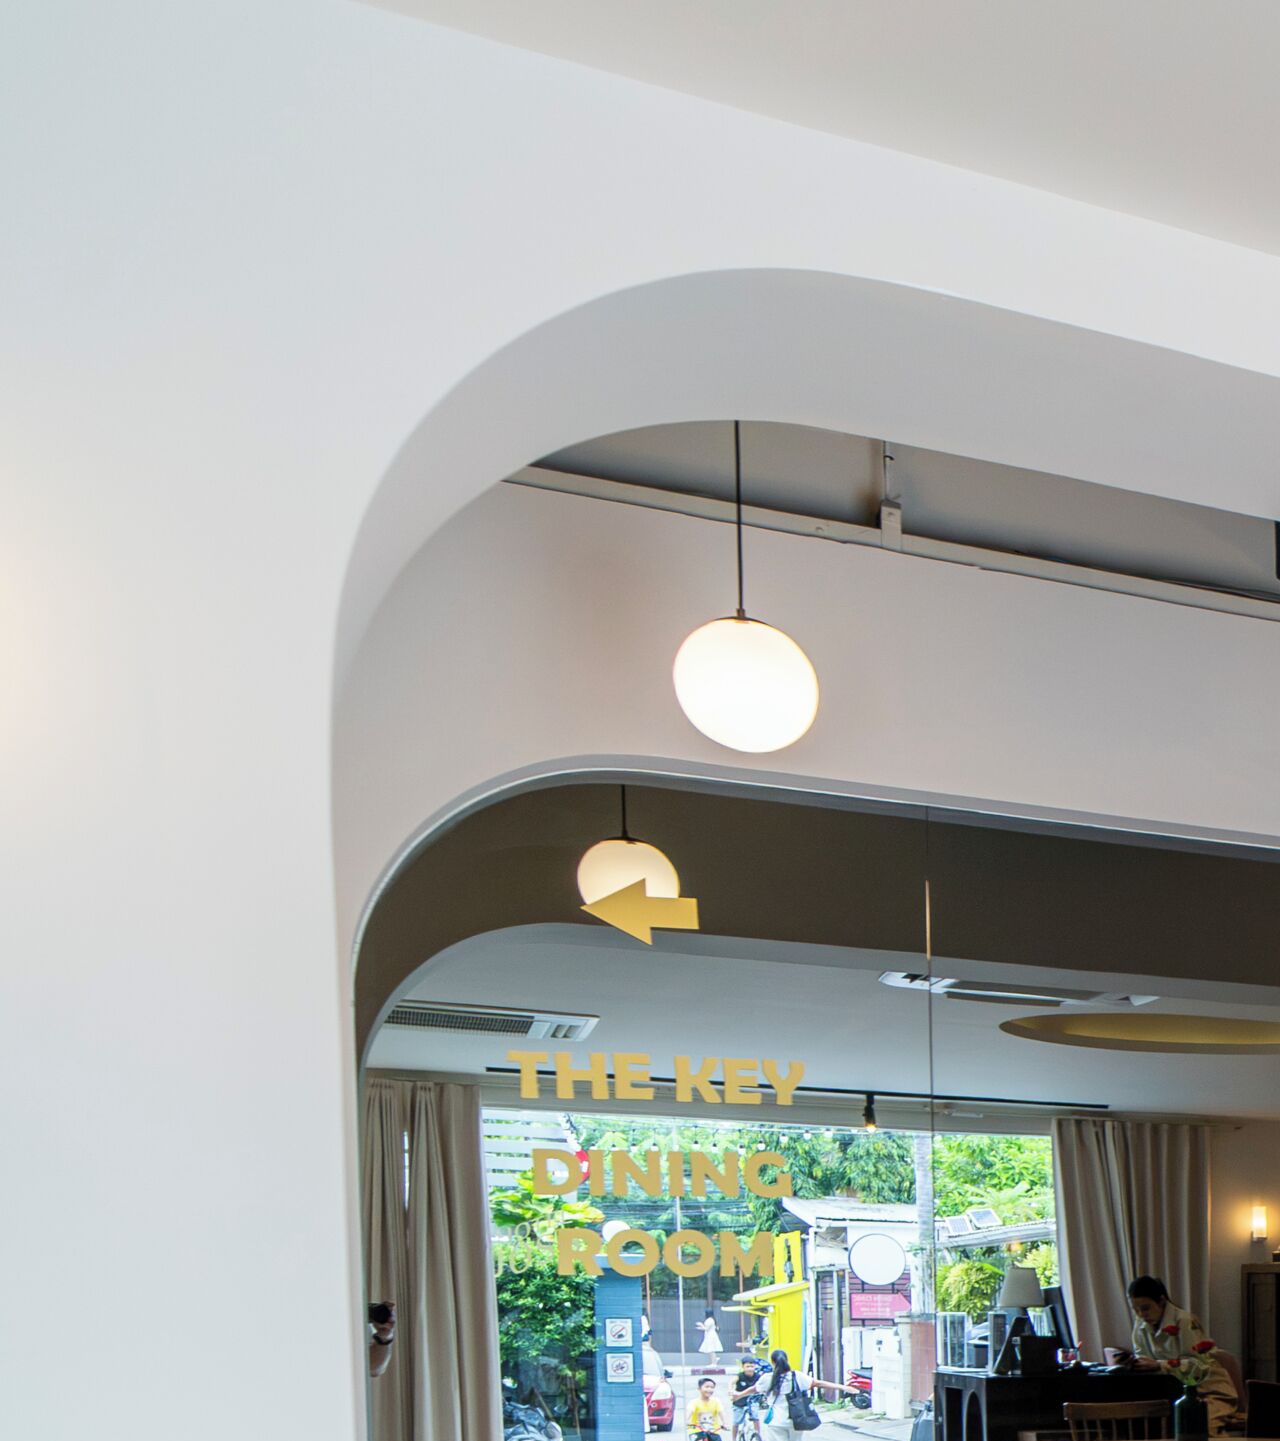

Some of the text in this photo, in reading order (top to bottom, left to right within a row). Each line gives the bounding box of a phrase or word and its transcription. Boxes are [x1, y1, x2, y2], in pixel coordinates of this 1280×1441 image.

[508, 1051, 804, 1105] THE KEY
[533, 1149, 794, 1198] DINING
[557, 1227, 777, 1278] ROOM
